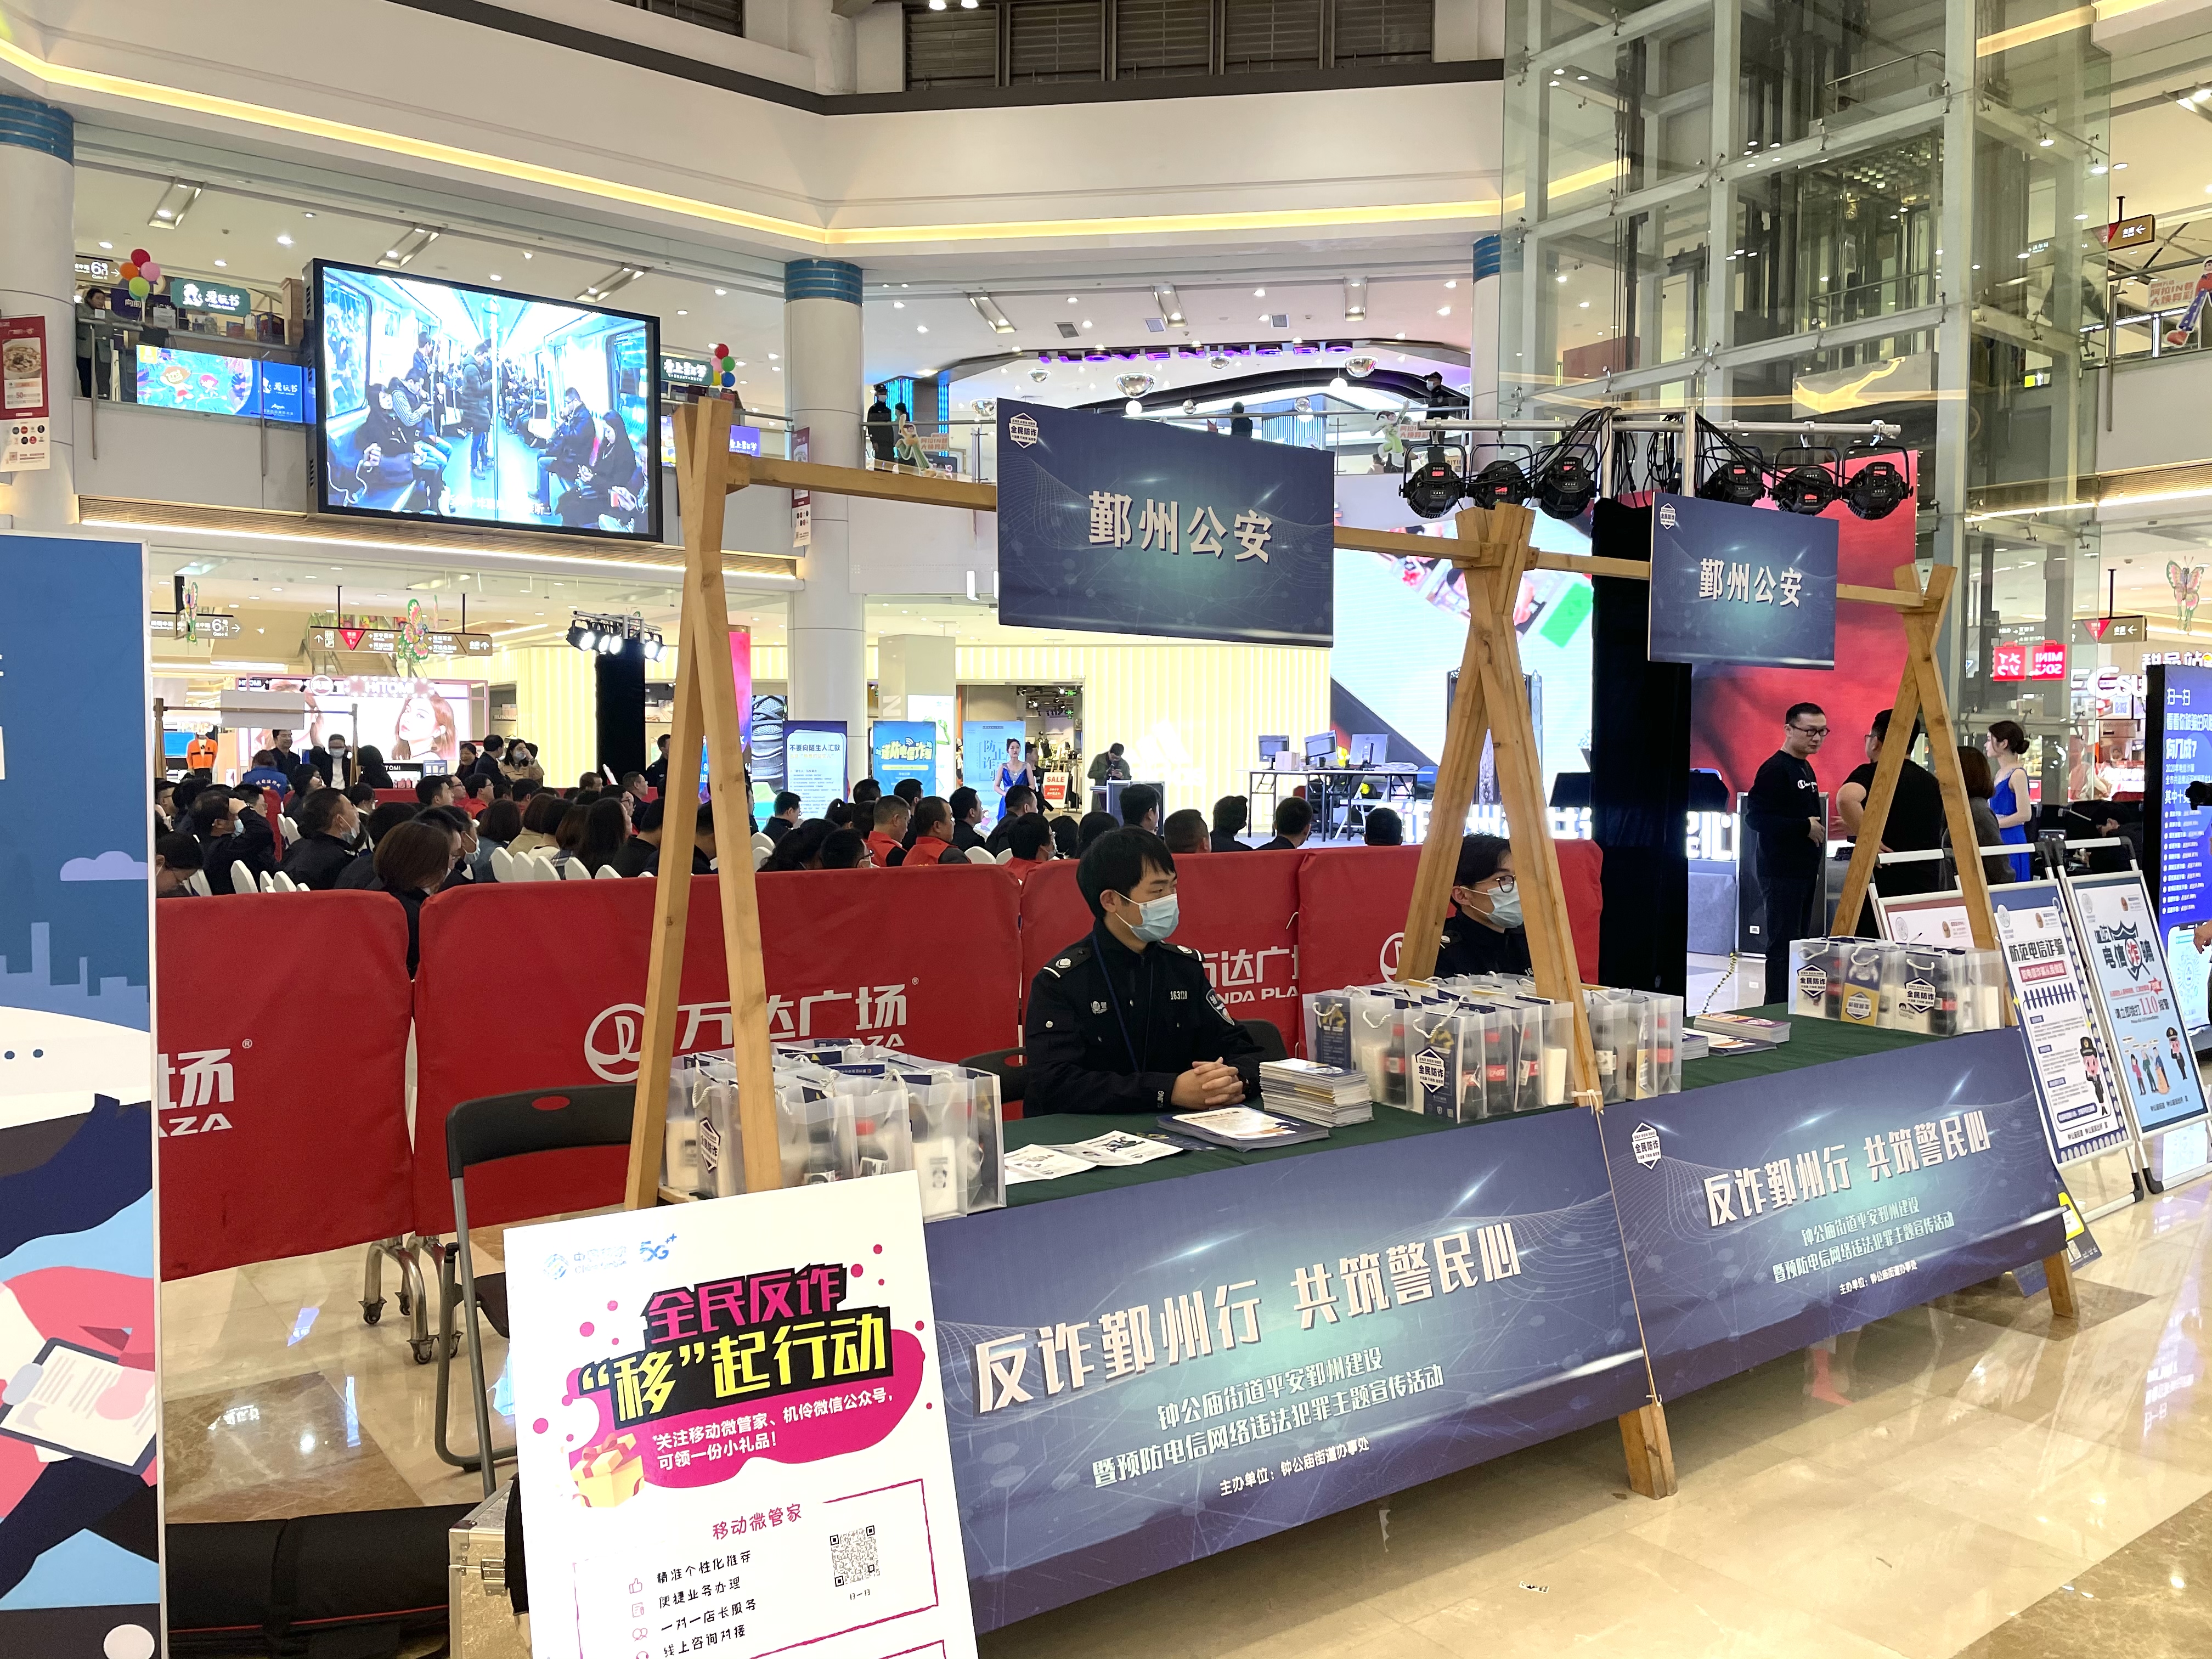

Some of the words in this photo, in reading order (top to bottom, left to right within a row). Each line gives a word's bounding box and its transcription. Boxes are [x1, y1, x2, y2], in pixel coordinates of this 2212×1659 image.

[1011, 426, 1037, 436] 全民防诈
[1089, 490, 1272, 563] 鄞州公安
[1699, 558, 1803, 607] 鄞州公安
[365, 681, 414, 693] HITOMI
[2167, 687, 2191, 706] 扫一扫
[2008, 938, 2066, 962] 防范电信诈骗
[1170, 990, 1188, 1000] 163118
[1218, 990, 1256, 1005] NDA
[1906, 990, 1935, 1001] 全民防诈
[1419, 1065, 1443, 1078] 全民防诈
[1703, 1144, 1850, 1227] 反诈鄞州行
[1863, 1109, 1991, 1183] 共筑警民心
[1801, 1196, 1920, 1248] 钟公庙街道平安鄞州建设
[1772, 1210, 1955, 1285] 暨预防电信网络违法犯罪主题宣传活动
[647, 1265, 845, 1344] 全民反诈
[973, 1279, 1261, 1414] 反诈鄞州行
[1291, 1222, 1521, 1330] 共筑警民心
[583, 1313, 887, 1422] “移”起行动
[1157, 1346, 1384, 1431] 钟公庙街道平安鄞州建设
[1092, 1363, 1444, 1487] 暨预防电信网络违法犯罪主题宣传活动
[712, 1504, 802, 1541] 移动微管家
[657, 1550, 751, 1584] 精准个性化推荐
[659, 1576, 741, 1609] 便捷业务办理
[661, 1599, 756, 1631] 一对一店长服务
[663, 1624, 746, 1658] 线上咨询对接
